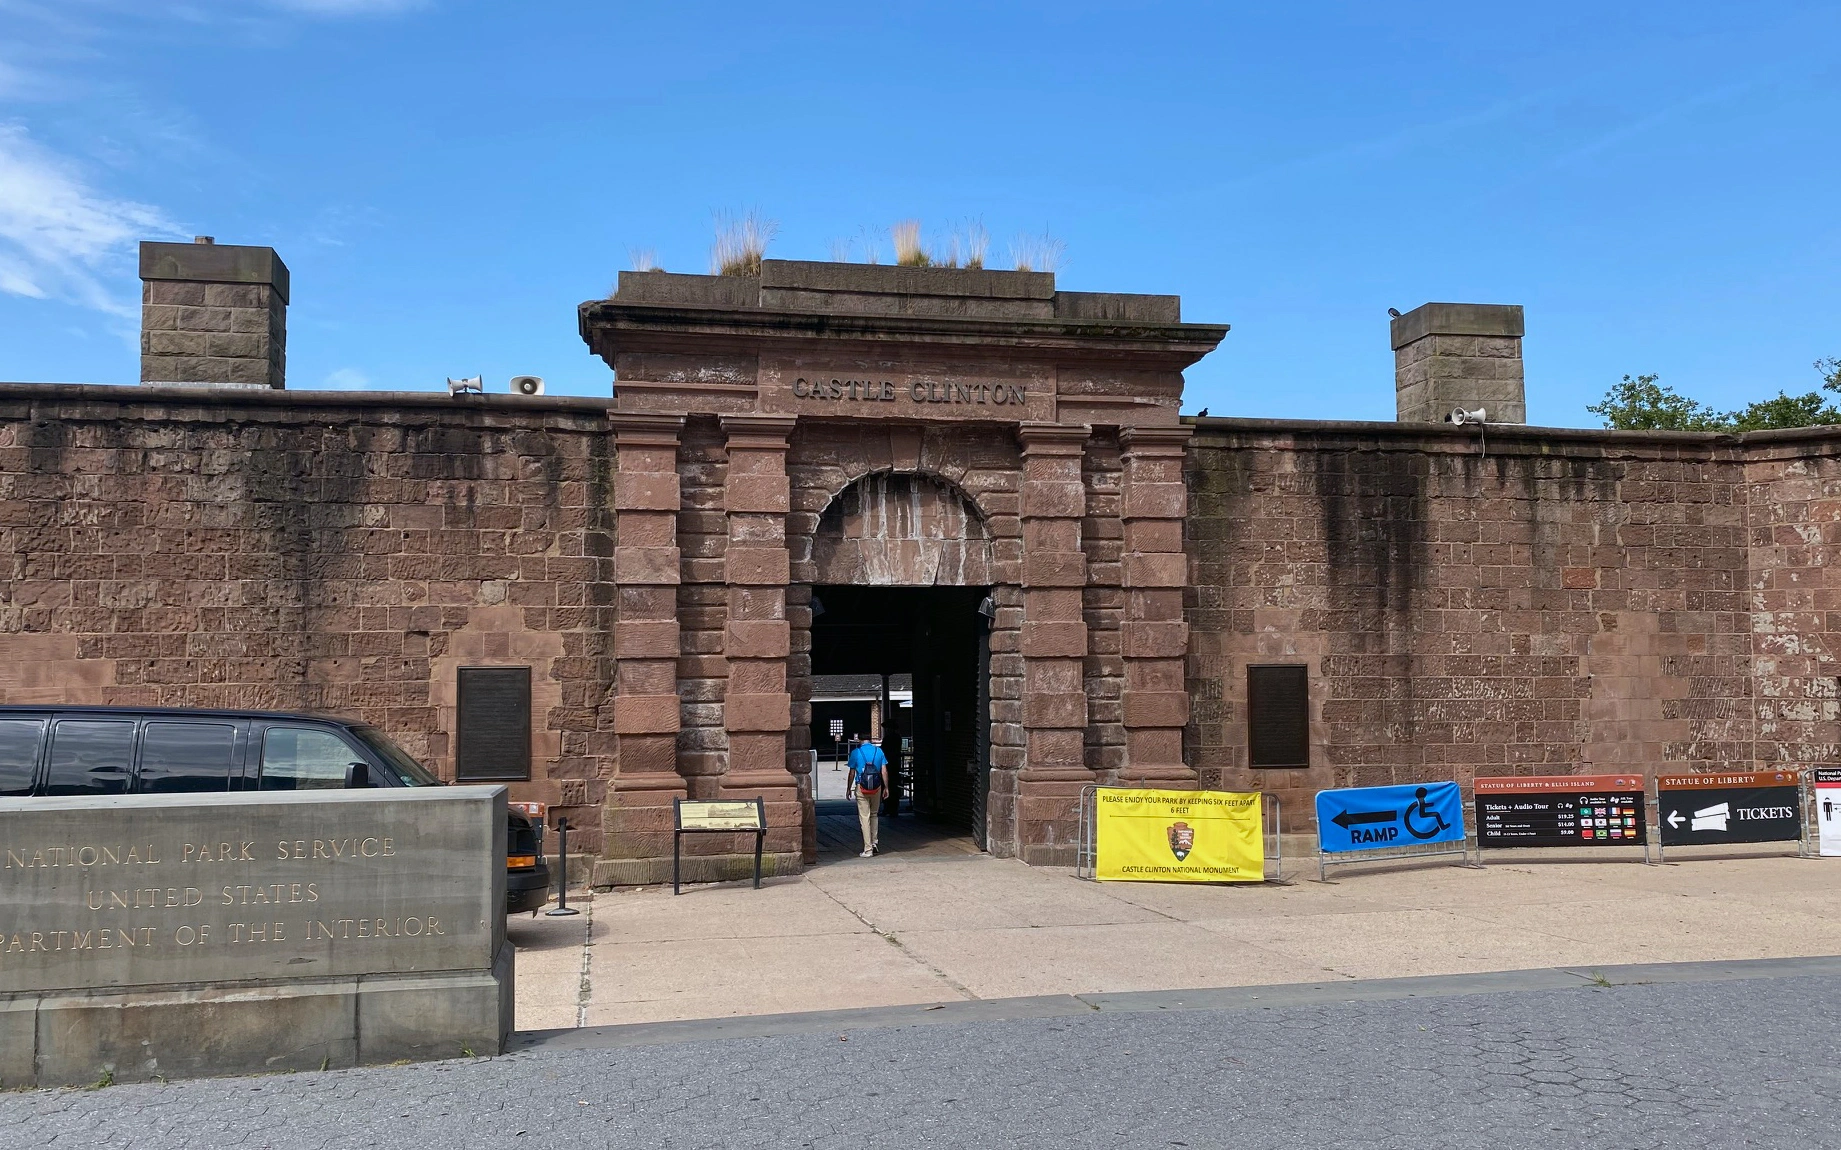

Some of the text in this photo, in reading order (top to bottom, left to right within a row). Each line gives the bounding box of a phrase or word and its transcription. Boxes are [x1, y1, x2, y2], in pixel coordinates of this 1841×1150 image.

[792, 377, 1027, 405] CASTLE CLINTON
[1718, 776, 1755, 784] LIBERTY
[1102, 795, 1256, 807] PLEASE ENJOY YOUR PARK BY KEEPING SIX FEET APART
[1737, 806, 1793, 820] TICKETS
[1351, 827, 1398, 844] RAMP
[5, 837, 397, 869] NATIONAL PARK SERVICE
[1122, 865, 1239, 874] CASTLE CLINTON NATIONAL MONUMENT
[87, 883, 320, 910] UNITED STATES
[175, 924, 211, 946] OF
[229, 921, 288, 944] THE
[304, 916, 446, 941] INTERIOR
